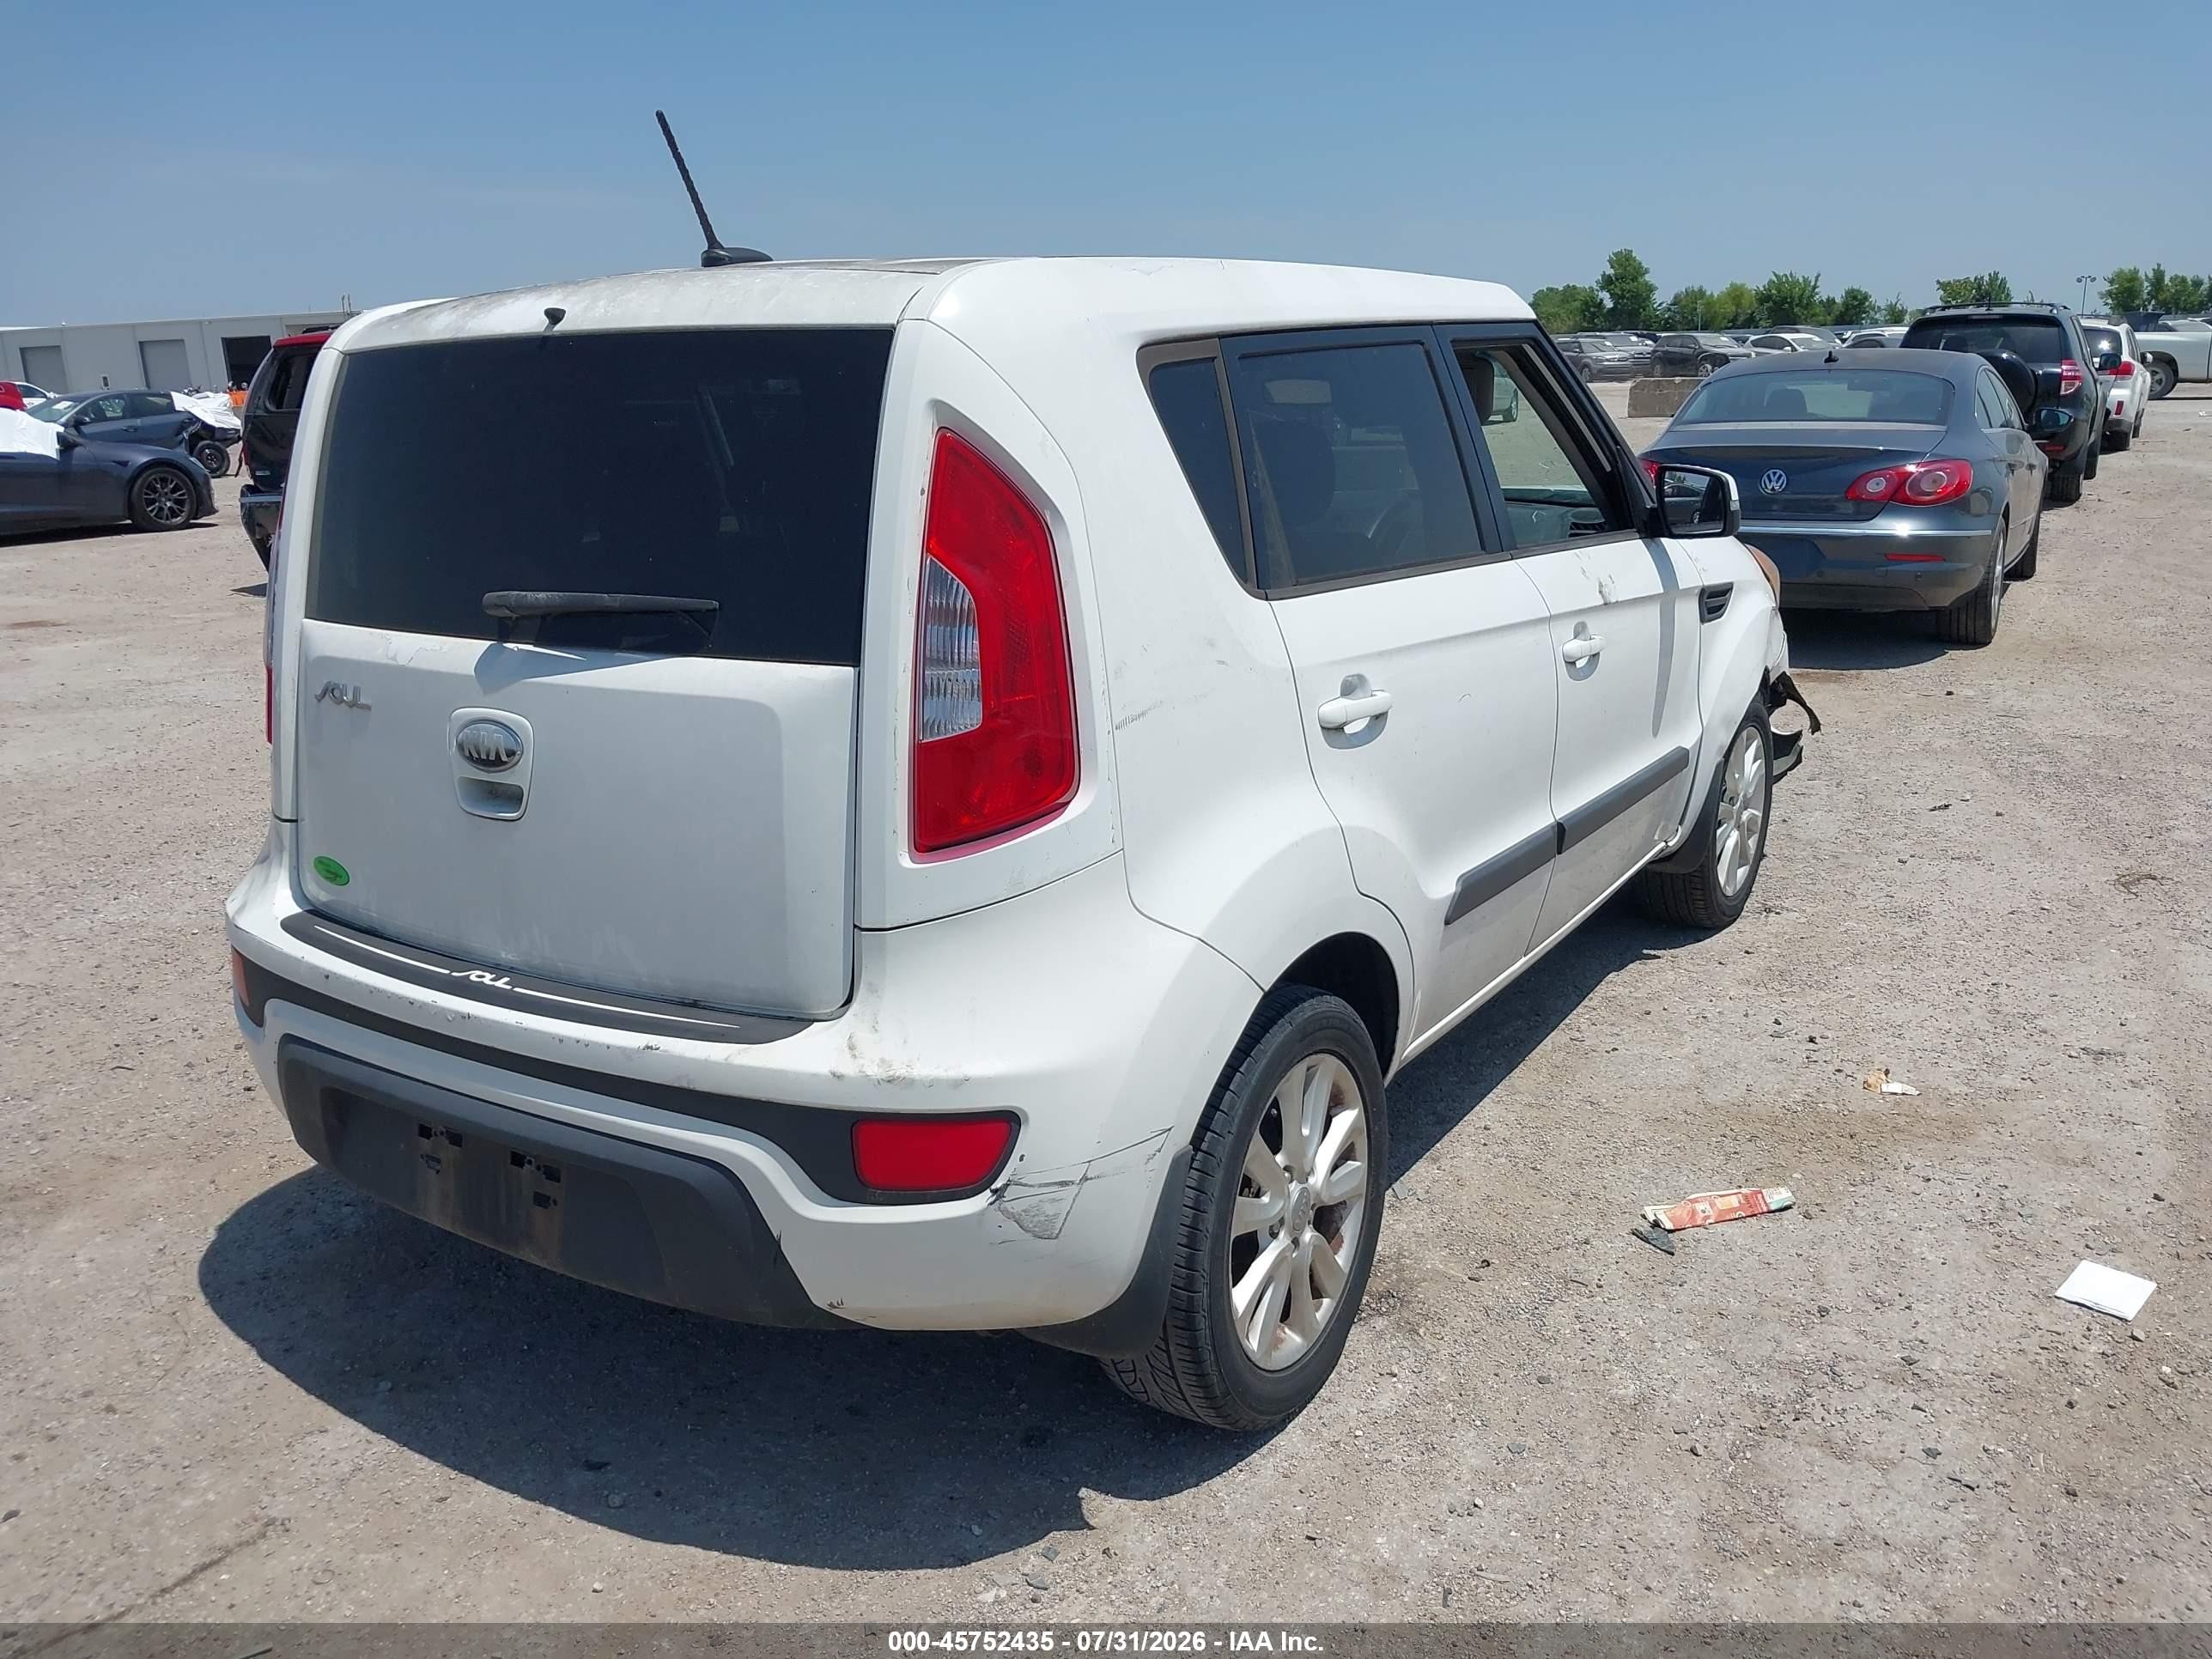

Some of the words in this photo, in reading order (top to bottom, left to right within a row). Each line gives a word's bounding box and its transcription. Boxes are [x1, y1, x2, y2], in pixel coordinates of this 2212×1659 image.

[1762, 470, 1786, 492] VW
[463, 730, 509, 763] KIA
[452, 969, 513, 990] SOUL
